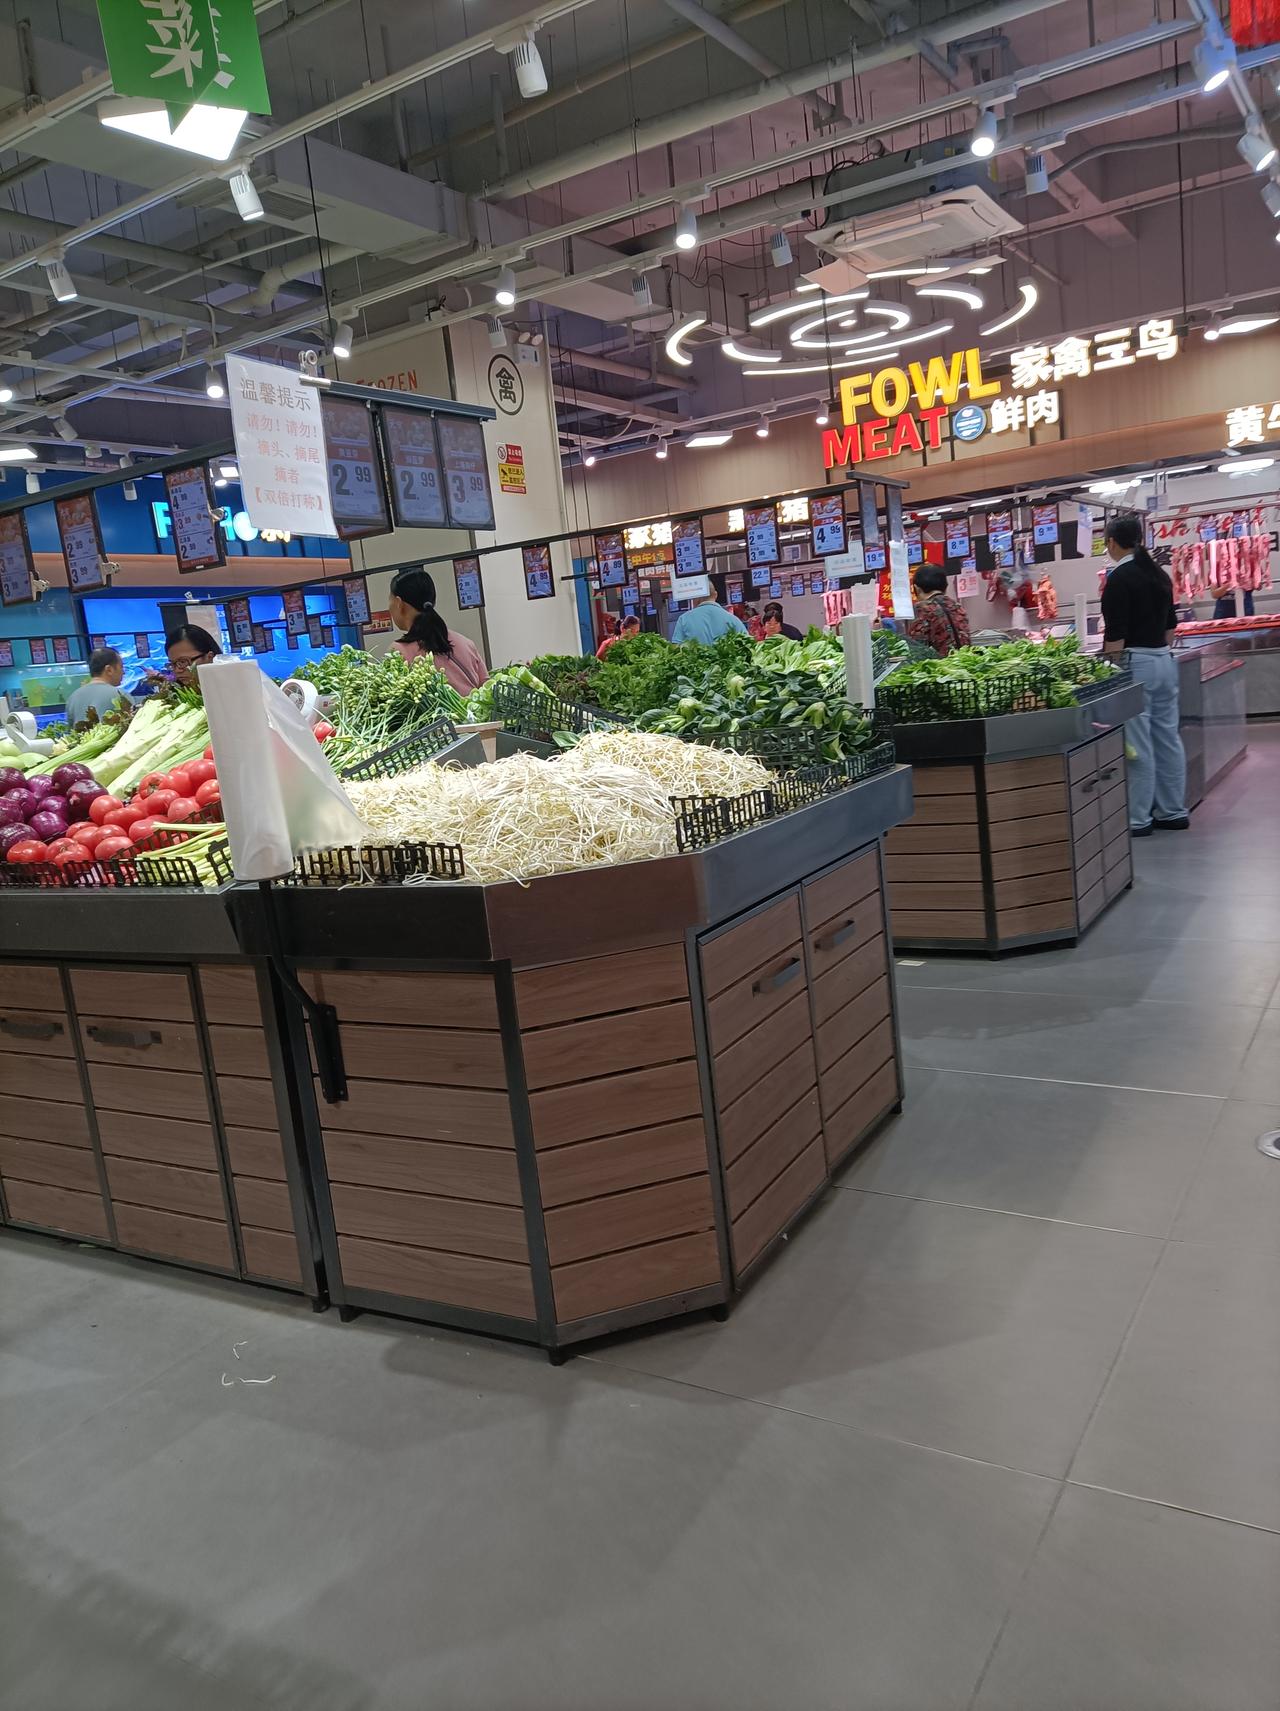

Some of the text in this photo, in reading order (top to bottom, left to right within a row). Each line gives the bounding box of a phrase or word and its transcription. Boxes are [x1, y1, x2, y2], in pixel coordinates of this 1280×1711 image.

[240, 377, 311, 411] 温馨提示
[839, 347, 1001, 427] FOWL
[990, 389, 1059, 434] 鲜肉
[821, 405, 949, 470] MEAT
